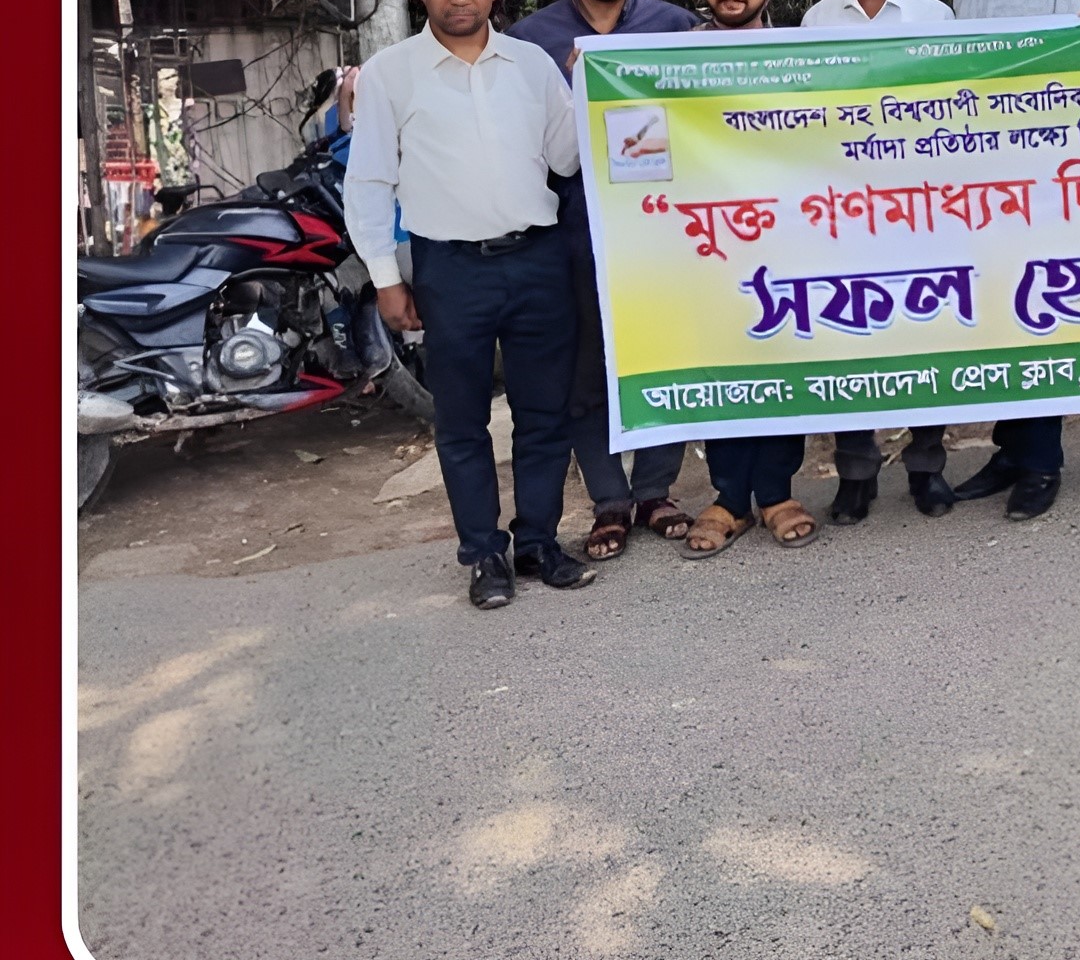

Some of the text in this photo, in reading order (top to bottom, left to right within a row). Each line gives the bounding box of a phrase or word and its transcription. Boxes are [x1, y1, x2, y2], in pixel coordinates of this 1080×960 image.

[722, 106, 828, 132] বাংলাদেশ
[836, 103, 875, 127] সহ
[880, 88, 979, 124] বিশ্বব্যাপী
[840, 132, 907, 161] মর্যাদা
[914, 123, 1001, 158] প্রতিষ্ঠার
[1007, 123, 1071, 150] লক্ষ্যে
[800, 179, 1038, 240] গণমাধ্যম
[741, 265, 977, 337] সফল
[804, 365, 939, 402] বাংলাদেশ
[951, 361, 1011, 392] প্রেস
